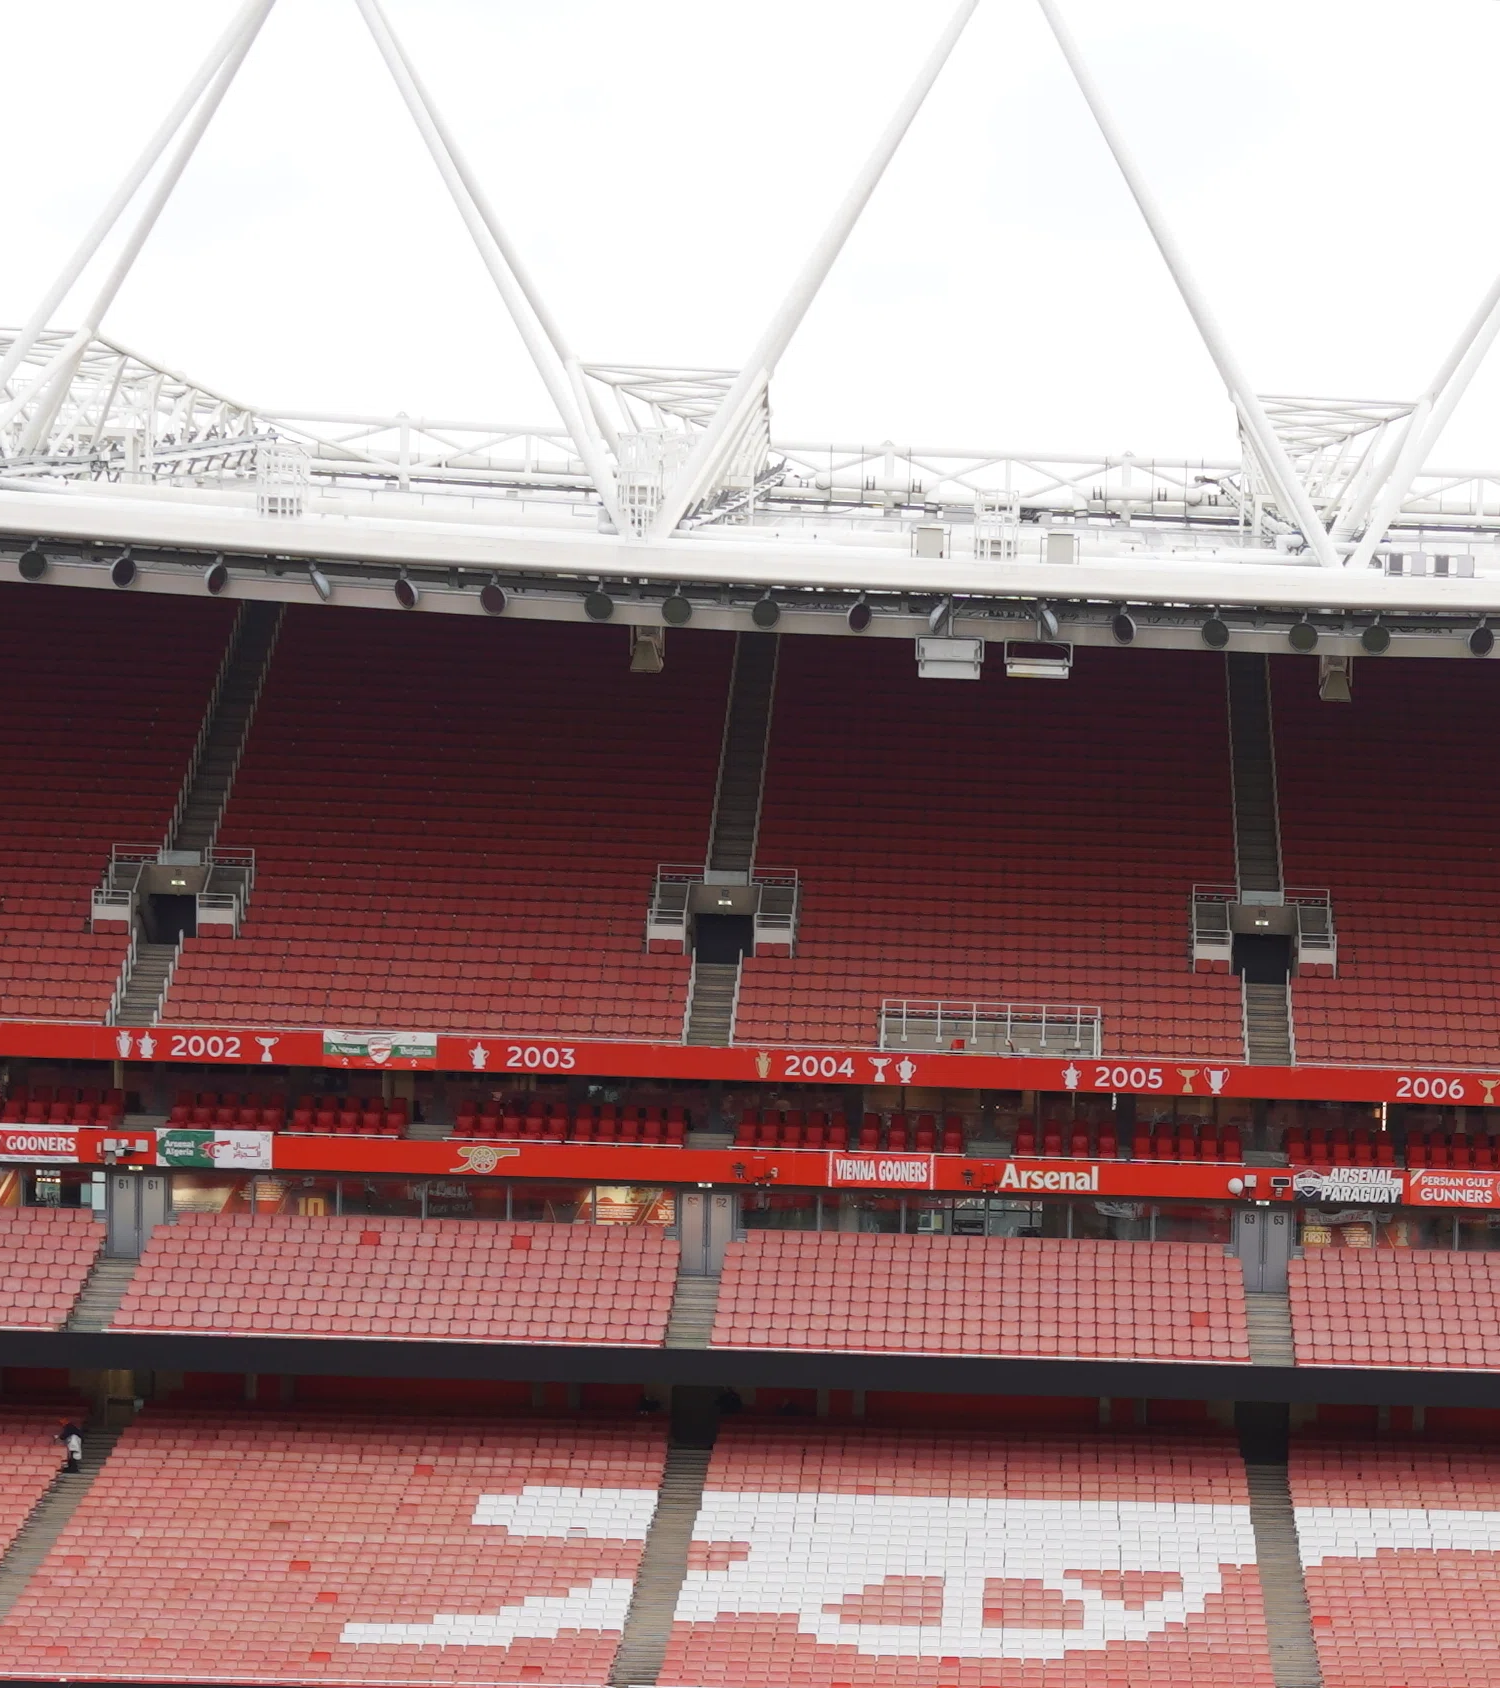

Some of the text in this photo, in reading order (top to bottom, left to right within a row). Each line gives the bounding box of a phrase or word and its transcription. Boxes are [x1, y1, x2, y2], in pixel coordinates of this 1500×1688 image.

[170, 1034, 242, 1058] 2002
[505, 1045, 577, 1069] 2003
[784, 1055, 856, 1078] 2004
[1094, 1065, 1164, 1089] 2005
[1395, 1076, 1466, 1100] 2006
[6, 1135, 77, 1152] GOONERS
[164, 1139, 195, 1148] Arsenal
[165, 1147, 194, 1157] Algeria
[835, 1157, 928, 1184] VIENNA GOONERS
[999, 1162, 1100, 1192] Arsenal
[1328, 1167, 1394, 1184] ARSENAL
[119, 1179, 129, 1189] 61
[148, 1180, 158, 1190] 61
[1420, 1175, 1495, 1188] PERSIAN GULF
[1320, 1186, 1400, 1204] PARAGUAY
[1420, 1187, 1493, 1204] GUNNERS
[1245, 1214, 1255, 1224] 63
[1273, 1215, 1284, 1225] 63
